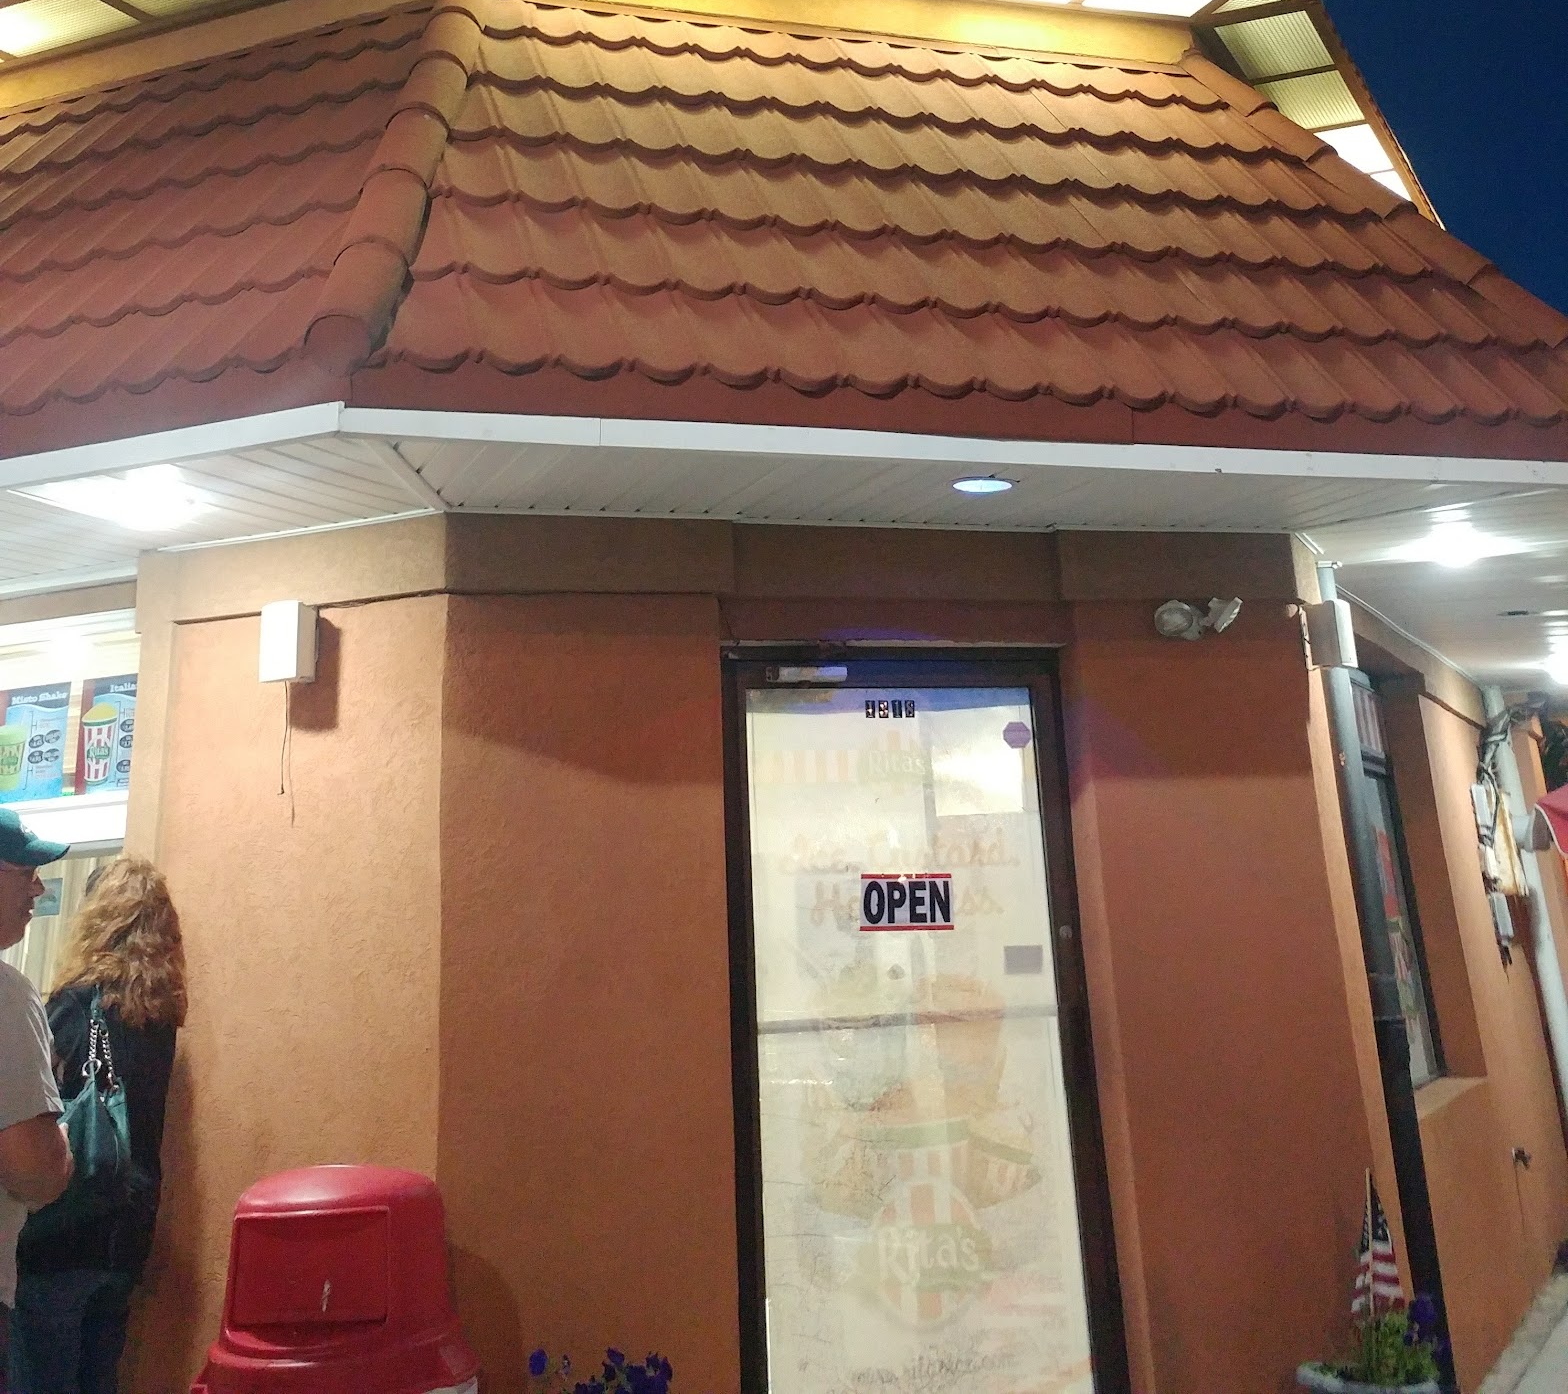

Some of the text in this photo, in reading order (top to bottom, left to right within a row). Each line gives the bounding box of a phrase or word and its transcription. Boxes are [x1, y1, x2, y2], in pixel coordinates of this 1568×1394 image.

[110, 683, 137, 693] Italia
[12, 691, 68, 705] Misto Shake
[863, 880, 951, 925] OPEN
